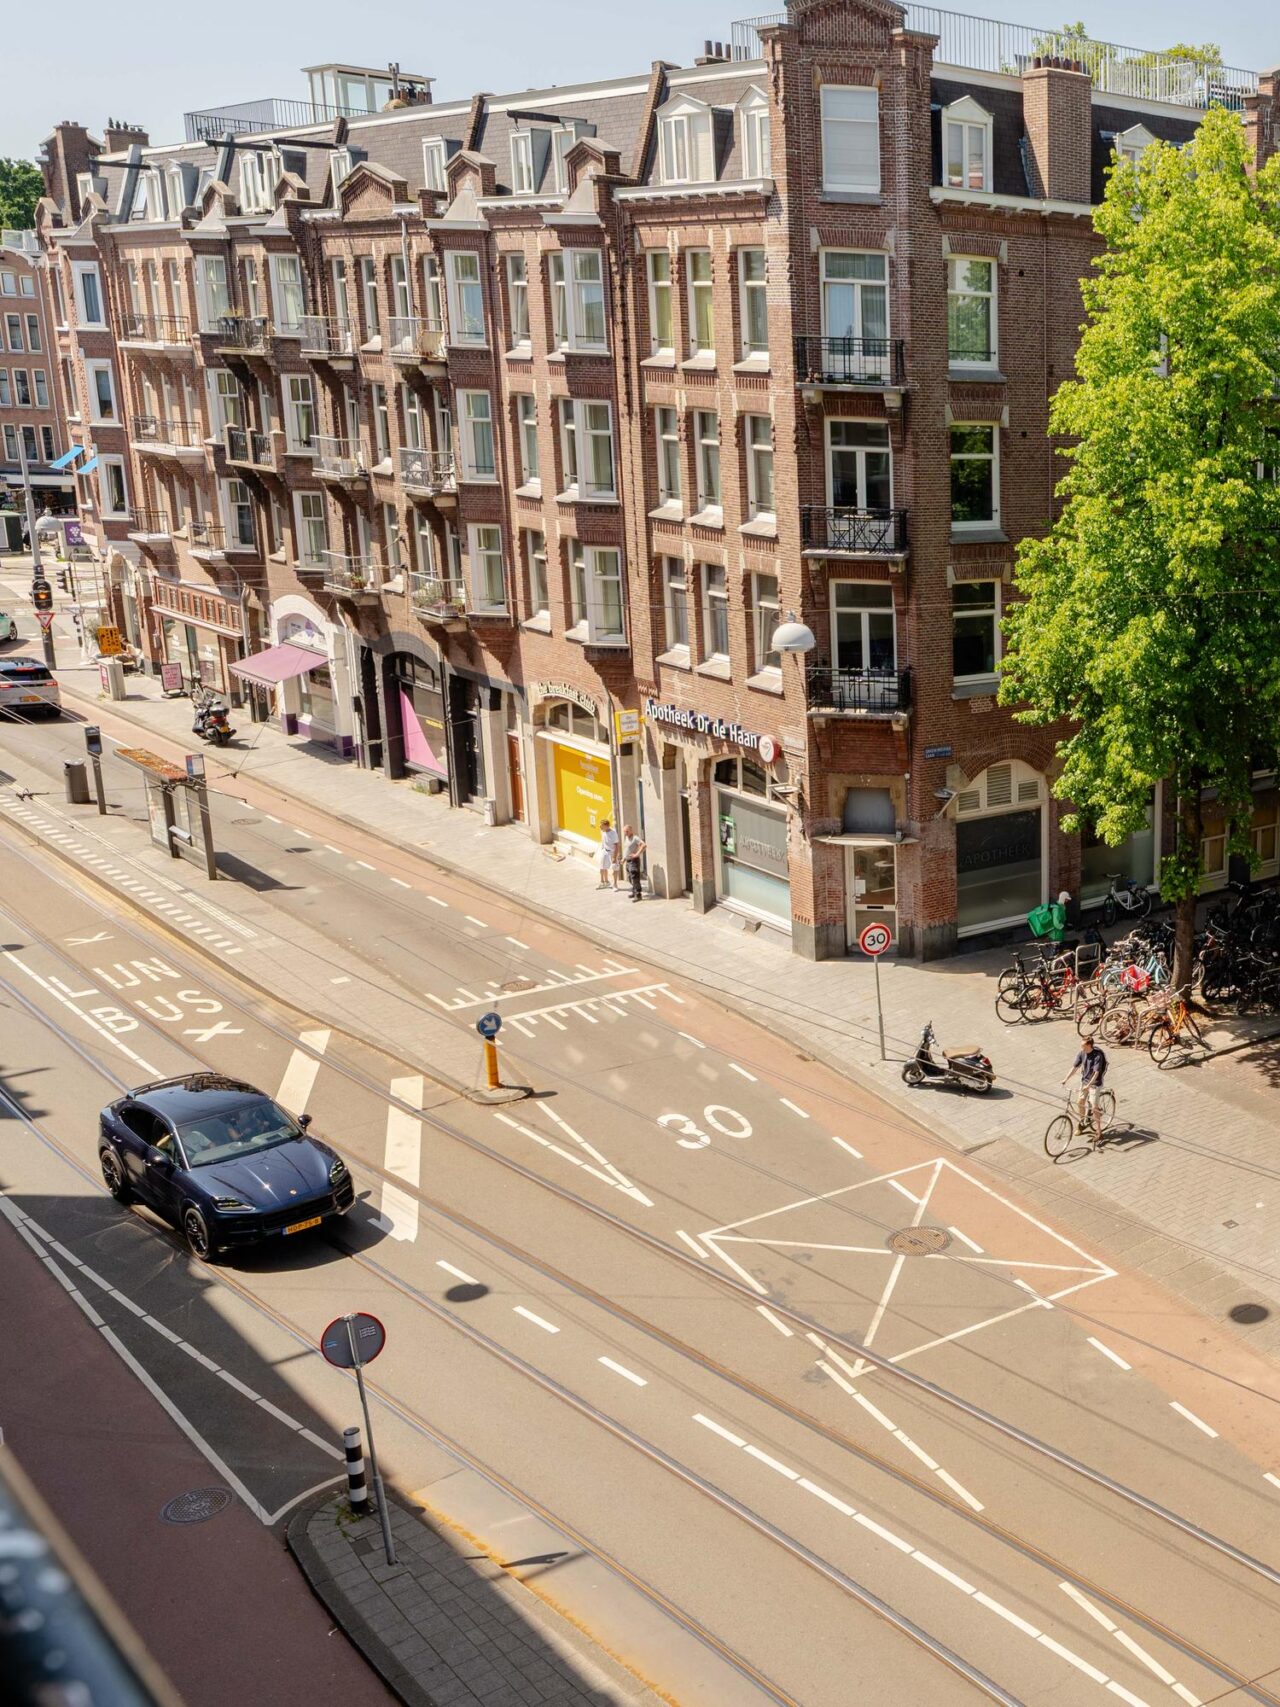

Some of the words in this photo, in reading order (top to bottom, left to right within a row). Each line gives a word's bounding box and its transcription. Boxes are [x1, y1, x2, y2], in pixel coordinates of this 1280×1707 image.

[548, 681, 579, 701] breakfast
[580, 694, 596, 713] club
[645, 698, 695, 730] Apotheek
[697, 714, 710, 734] Dr
[712, 720, 726, 740] de
[729, 724, 758, 749] Haan
[867, 933, 885, 946] 30
[89, 989, 223, 1034] BUS
[657, 1104, 753, 1149] 30
